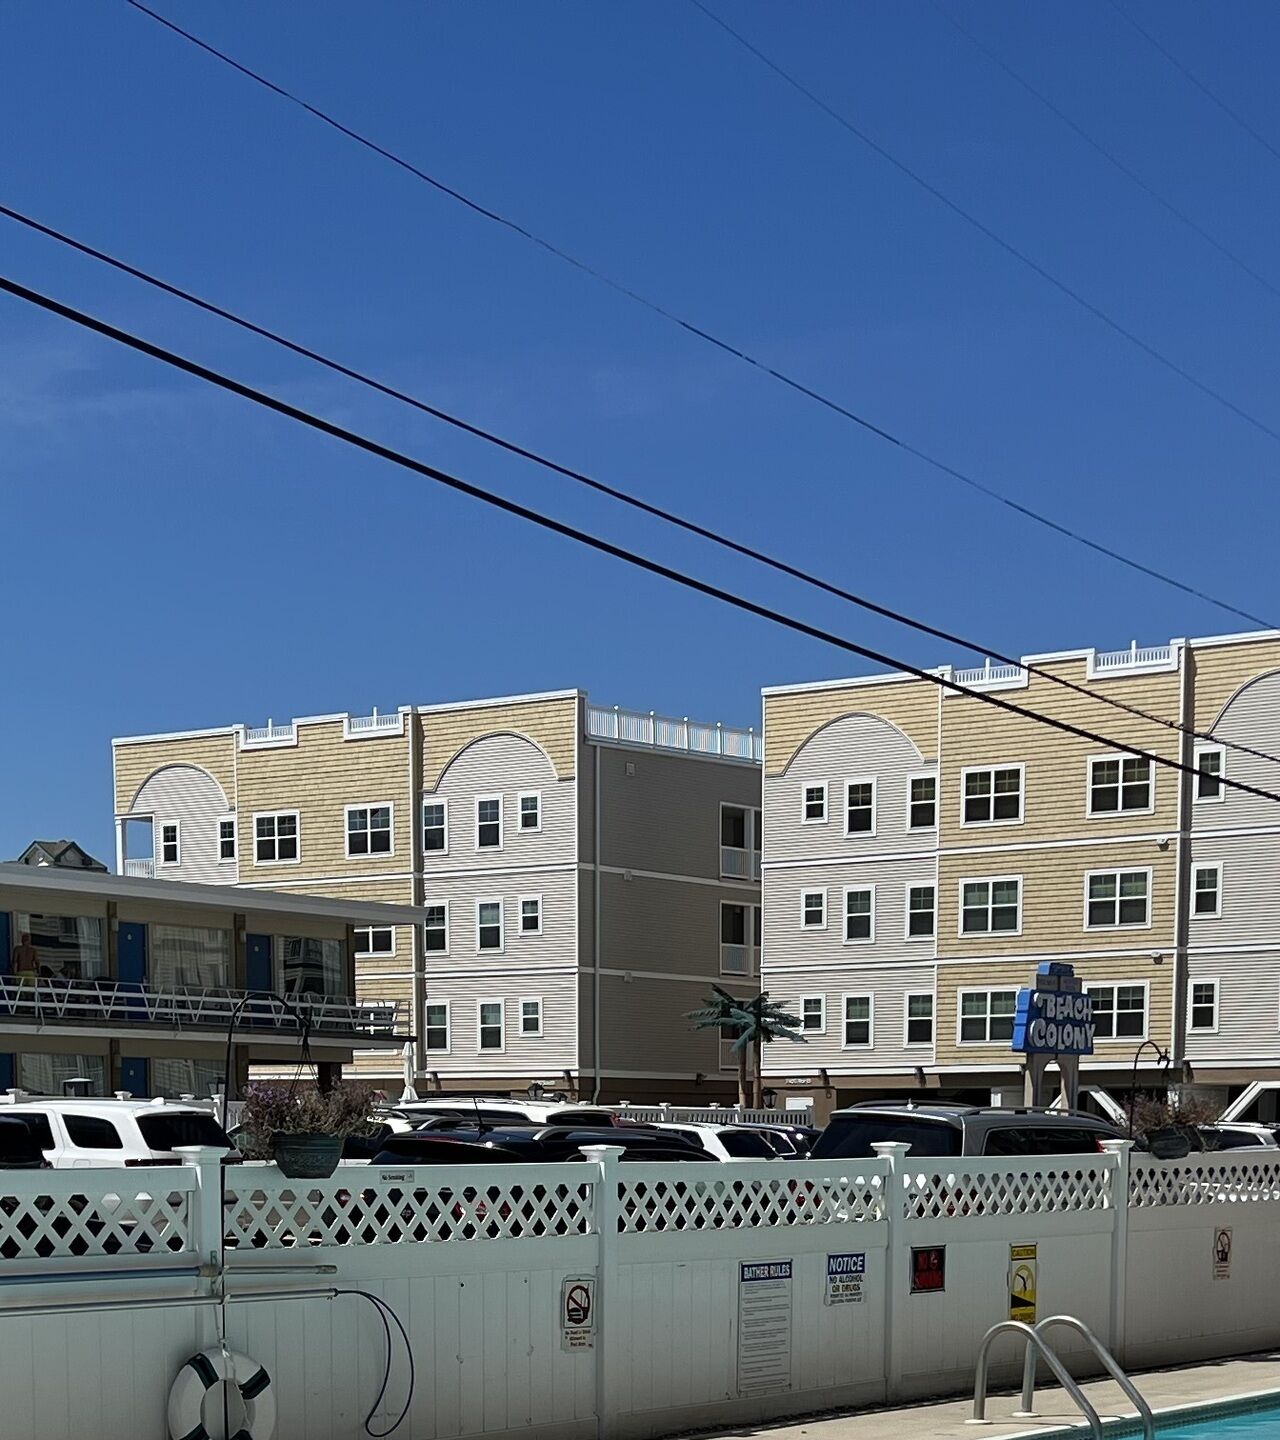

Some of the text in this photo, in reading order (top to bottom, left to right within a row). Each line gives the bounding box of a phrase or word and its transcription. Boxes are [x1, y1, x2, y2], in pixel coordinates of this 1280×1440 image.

[1033, 993, 1093, 1021] BEACH
[1029, 1018, 1096, 1050] COLONY
[744, 1264, 790, 1279] BATHER RULES
[829, 1256, 863, 1272] NOTICE
